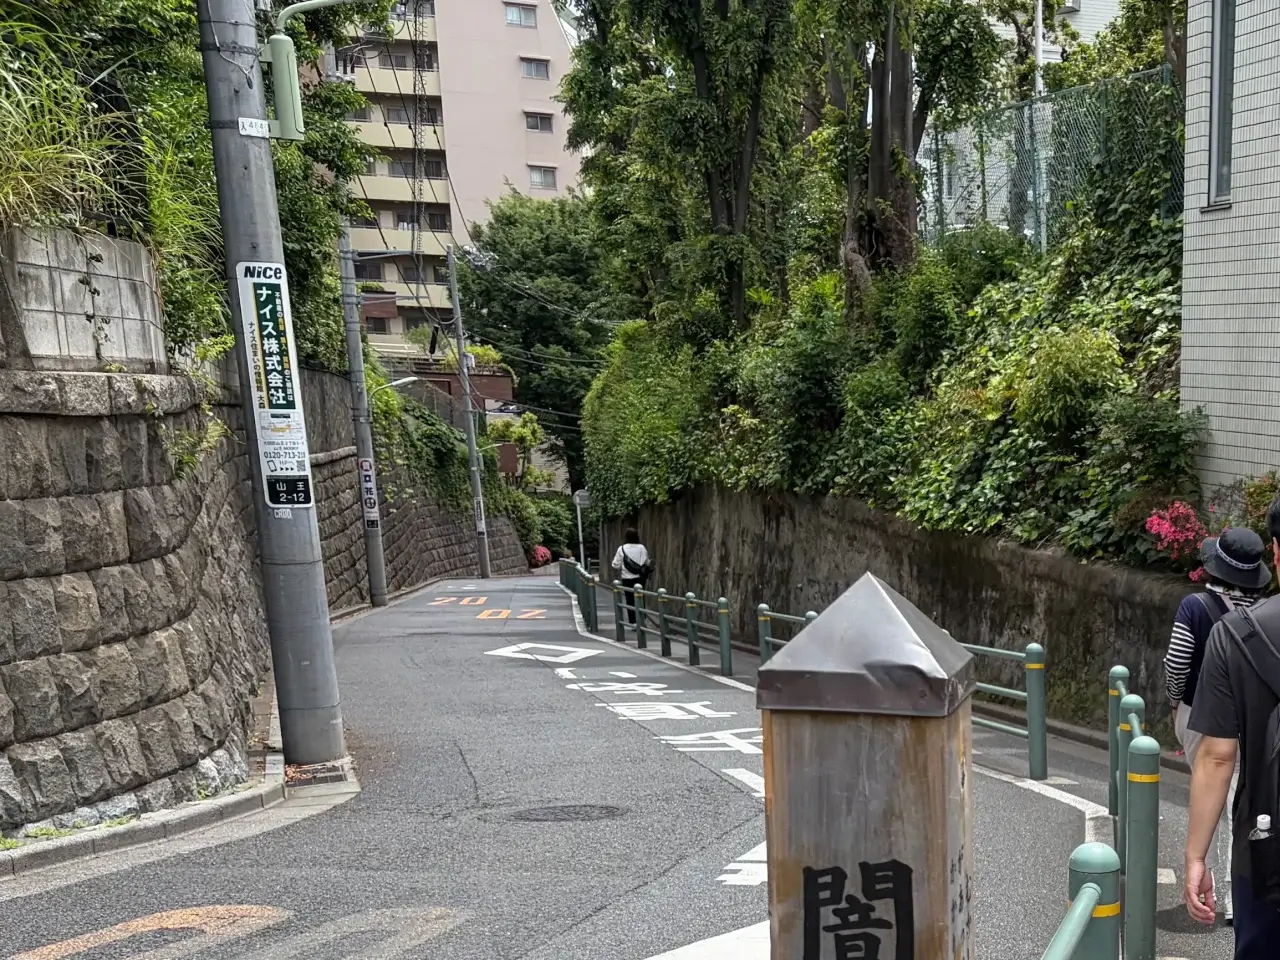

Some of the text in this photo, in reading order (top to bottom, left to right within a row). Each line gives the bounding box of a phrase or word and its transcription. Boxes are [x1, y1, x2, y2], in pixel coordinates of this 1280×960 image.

[257, 286, 287, 405] ナイス株式会社
[276, 481, 305, 491] 山王
[279, 492, 305, 502] 2-12
[427, 596, 488, 605] 20
